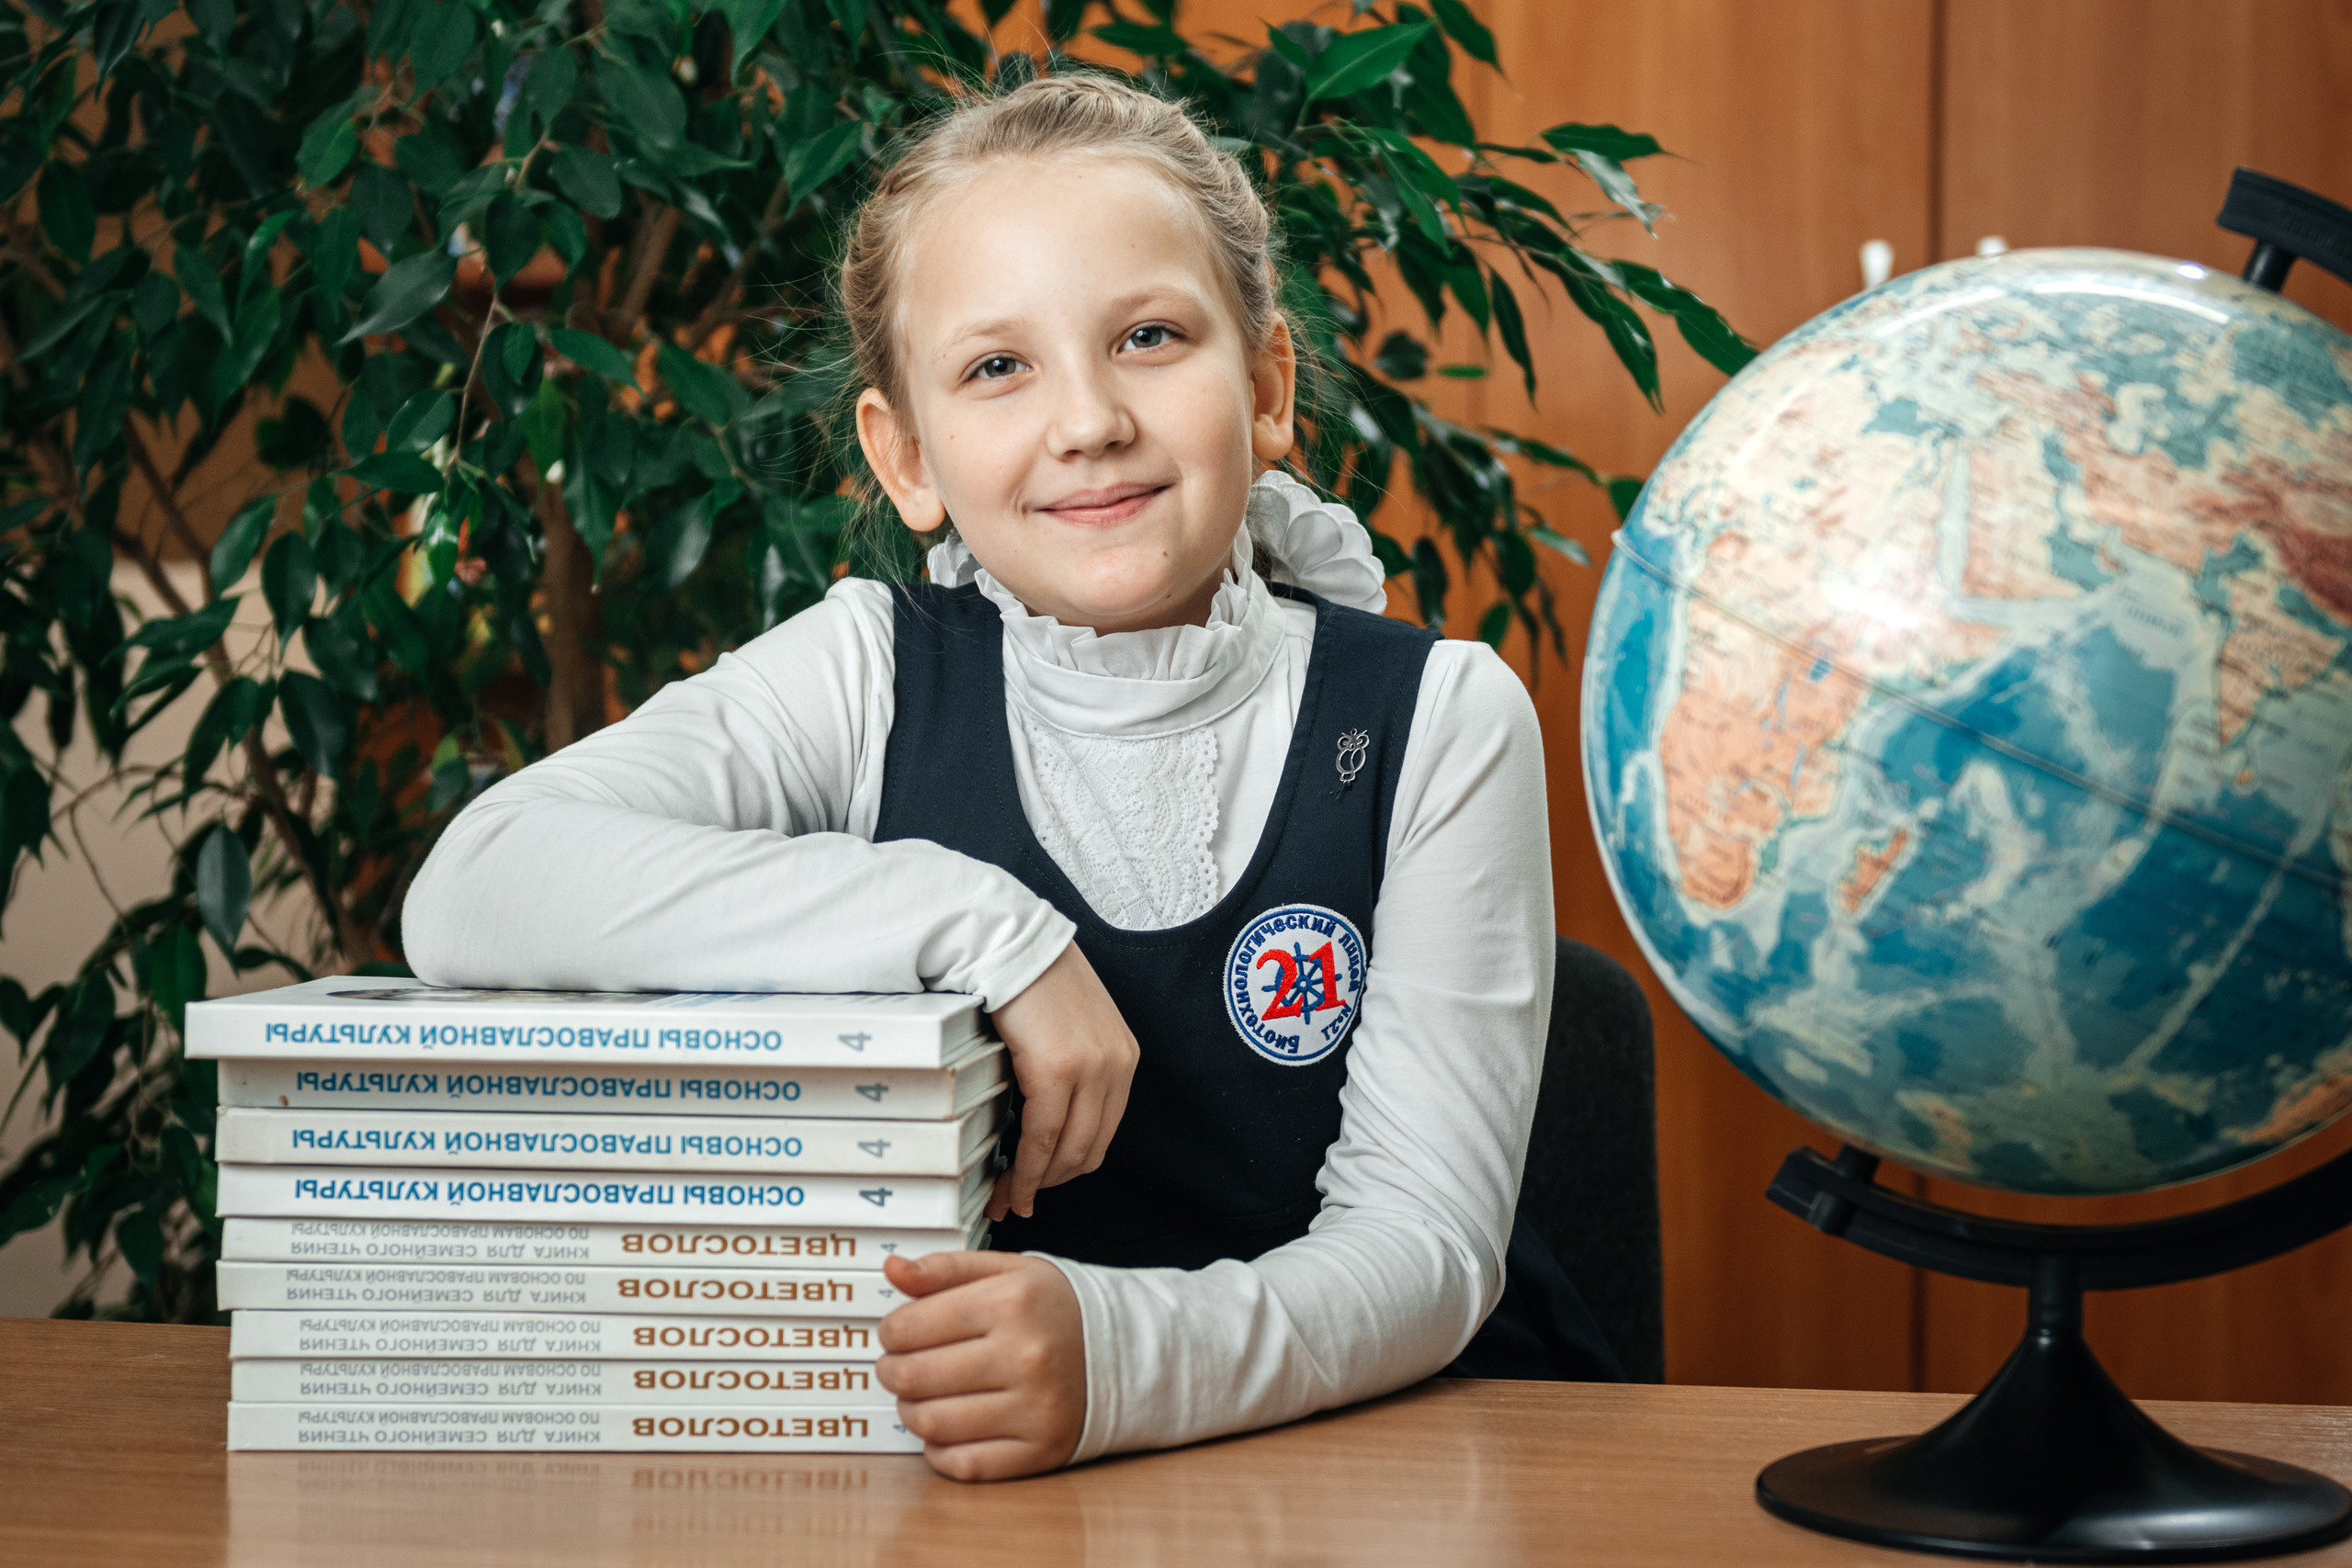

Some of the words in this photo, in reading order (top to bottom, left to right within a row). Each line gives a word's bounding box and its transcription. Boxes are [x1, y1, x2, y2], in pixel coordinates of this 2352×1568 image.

[1256, 941, 1346, 1021] 21
[266, 1023, 410, 1043] КУЛЬТУРЫ
[420, 1025, 649, 1048] ПРАВОСЛАВНОЙ
[660, 1030, 782, 1051] ОСНОВЫ
[838, 1032, 872, 1052] 4
[297, 1072, 437, 1092] КУЛЬТУРЫ
[447, 1073, 671, 1098] ПРАВОСЛАВНОЙ
[681, 1079, 800, 1100] ОСНОВЫ
[854, 1081, 891, 1101] 4
[293, 1130, 435, 1149] КУЛЬТУРЫ
[446, 1132, 671, 1154] ПРАВОСЛАВНОЙ
[682, 1136, 802, 1156] ОСНОВЫ
[857, 1139, 890, 1157] 4
[296, 1179, 437, 1200] КУЛЬТУРЫ
[448, 1182, 673, 1205] ПРАВОСЛАВНОЙ
[684, 1186, 804, 1205] ОСНОВЫ
[859, 1187, 893, 1206] 4
[291, 1223, 367, 1235] КУЛЬТУРЫ
[369, 1224, 489, 1237] ПРАВОСЛАВНОЙ
[491, 1224, 567, 1238] ОСНОВАМ
[569, 1225, 590, 1239] ПО
[291, 1242, 360, 1255] ЧТЕНИЯ
[366, 1244, 477, 1258] СЕМЕЙНОГО
[487, 1244, 525, 1258] ДЛЯ
[622, 1233, 857, 1256] ЦВЕТОСЛОВ
[534, 1247, 589, 1258] КНИГА
[287, 1269, 361, 1281] КУЛЬТУРЫ
[366, 1269, 484, 1284] ПРАВОСЛАВНОЙ
[488, 1271, 561, 1284] ОСНОВАМ
[564, 1272, 585, 1285] ПО
[287, 1288, 356, 1300] ЧТЕНИЯ
[363, 1289, 473, 1303] СЕМЕЙНОГО
[483, 1289, 521, 1303] ДЛЯ
[530, 1292, 586, 1303] КНИГА
[617, 1280, 853, 1302] ЦВЕТОСЛОВ
[300, 1319, 376, 1331] КУЛЬТУРЫ
[379, 1319, 499, 1334] ПРАВОСЛАВНОЙ
[503, 1320, 576, 1333] ОСНОВАМ
[580, 1320, 600, 1334] ПО
[634, 1325, 868, 1348] ЦВЕТОСЛОВ
[300, 1338, 370, 1350] ЧТЕНИЯ
[376, 1338, 488, 1354] СЕМЕЙНОГО
[498, 1337, 537, 1352] ДЛЯ
[546, 1340, 600, 1352] КНИГА
[299, 1362, 377, 1376] КУЛЬТУРЫ
[379, 1362, 500, 1378] ПРАВОСЛАВНОЙ
[503, 1362, 578, 1376] ОСНОВАМ
[580, 1363, 601, 1376] ПО
[634, 1368, 868, 1390] ЦВЕТОСЛОВ
[300, 1382, 370, 1394] ЧТЕНИЯ
[376, 1382, 489, 1397] СЕМЕЙНОГО
[499, 1382, 537, 1395] ДЛЯ
[546, 1383, 601, 1395] КНИГА
[299, 1411, 375, 1424] КУЛЬТУРЫ
[379, 1411, 499, 1426] ПРАВОСЛАВНОЙ
[503, 1412, 575, 1424] ОСНОВАМ
[579, 1412, 599, 1425] ПО
[632, 1416, 867, 1437] ЦВЕТОСЛОВ
[299, 1430, 369, 1442] ЧТЕНИЯ
[375, 1430, 487, 1444] СЕМЕЙНОГО
[497, 1429, 536, 1443] ДЛЯ
[545, 1431, 600, 1443] КНИГА
